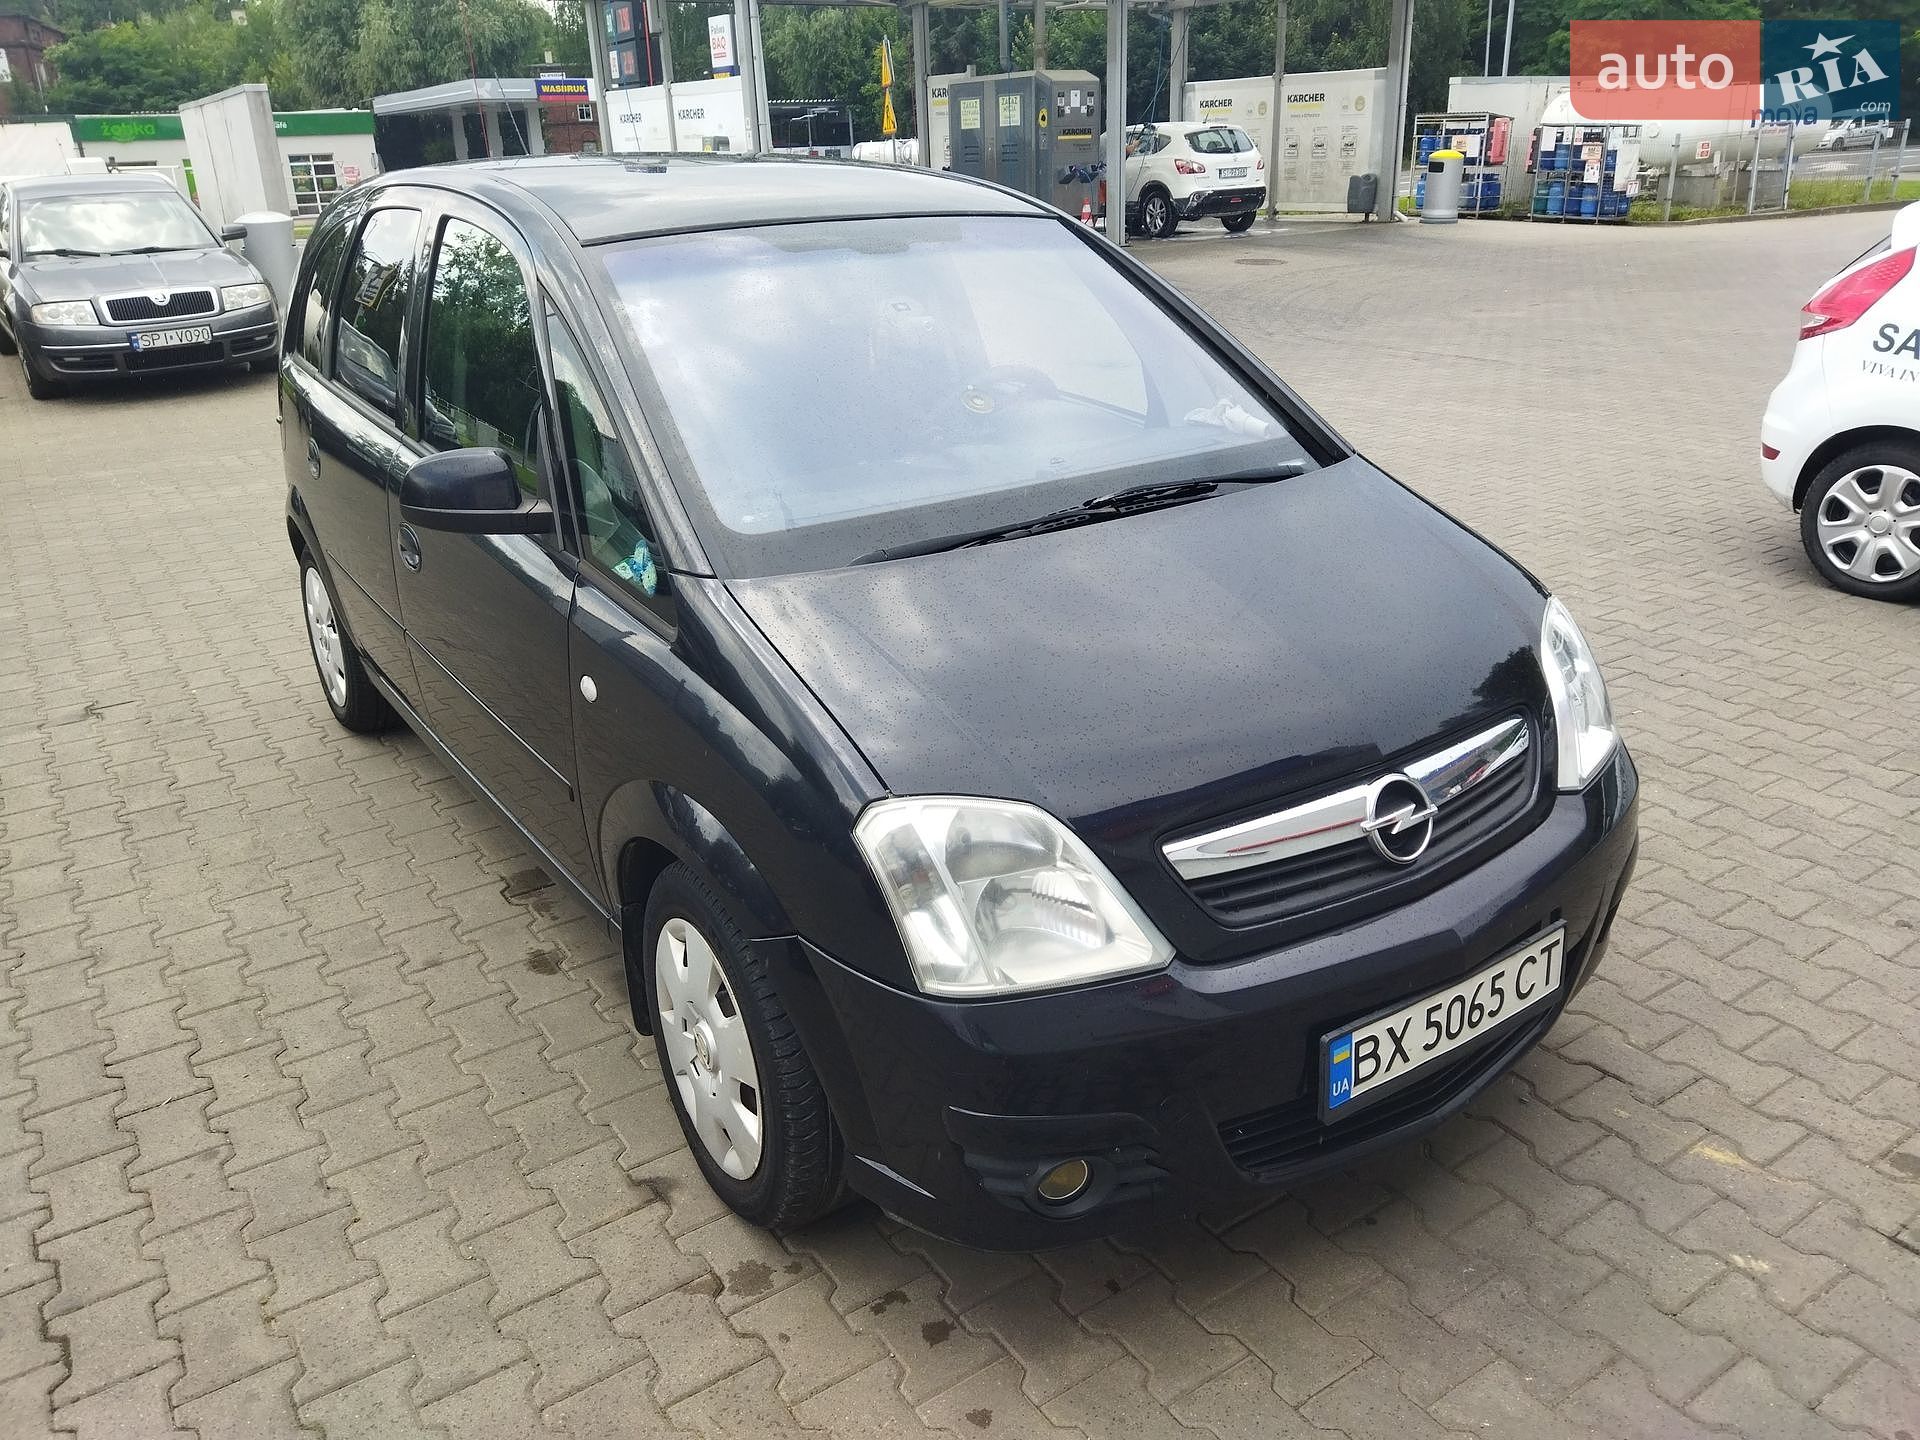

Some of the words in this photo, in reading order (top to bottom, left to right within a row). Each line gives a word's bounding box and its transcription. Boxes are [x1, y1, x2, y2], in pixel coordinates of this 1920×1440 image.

[931, 87, 949, 98] KÄR
[1287, 93, 1325, 103] KÄRCHER
[1873, 323, 1920, 360] SA
[1353, 1016, 1412, 1088] BX
[1423, 970, 1505, 1051] 5065
[1515, 938, 1561, 1000] CT
[1332, 1079, 1350, 1097] UA
